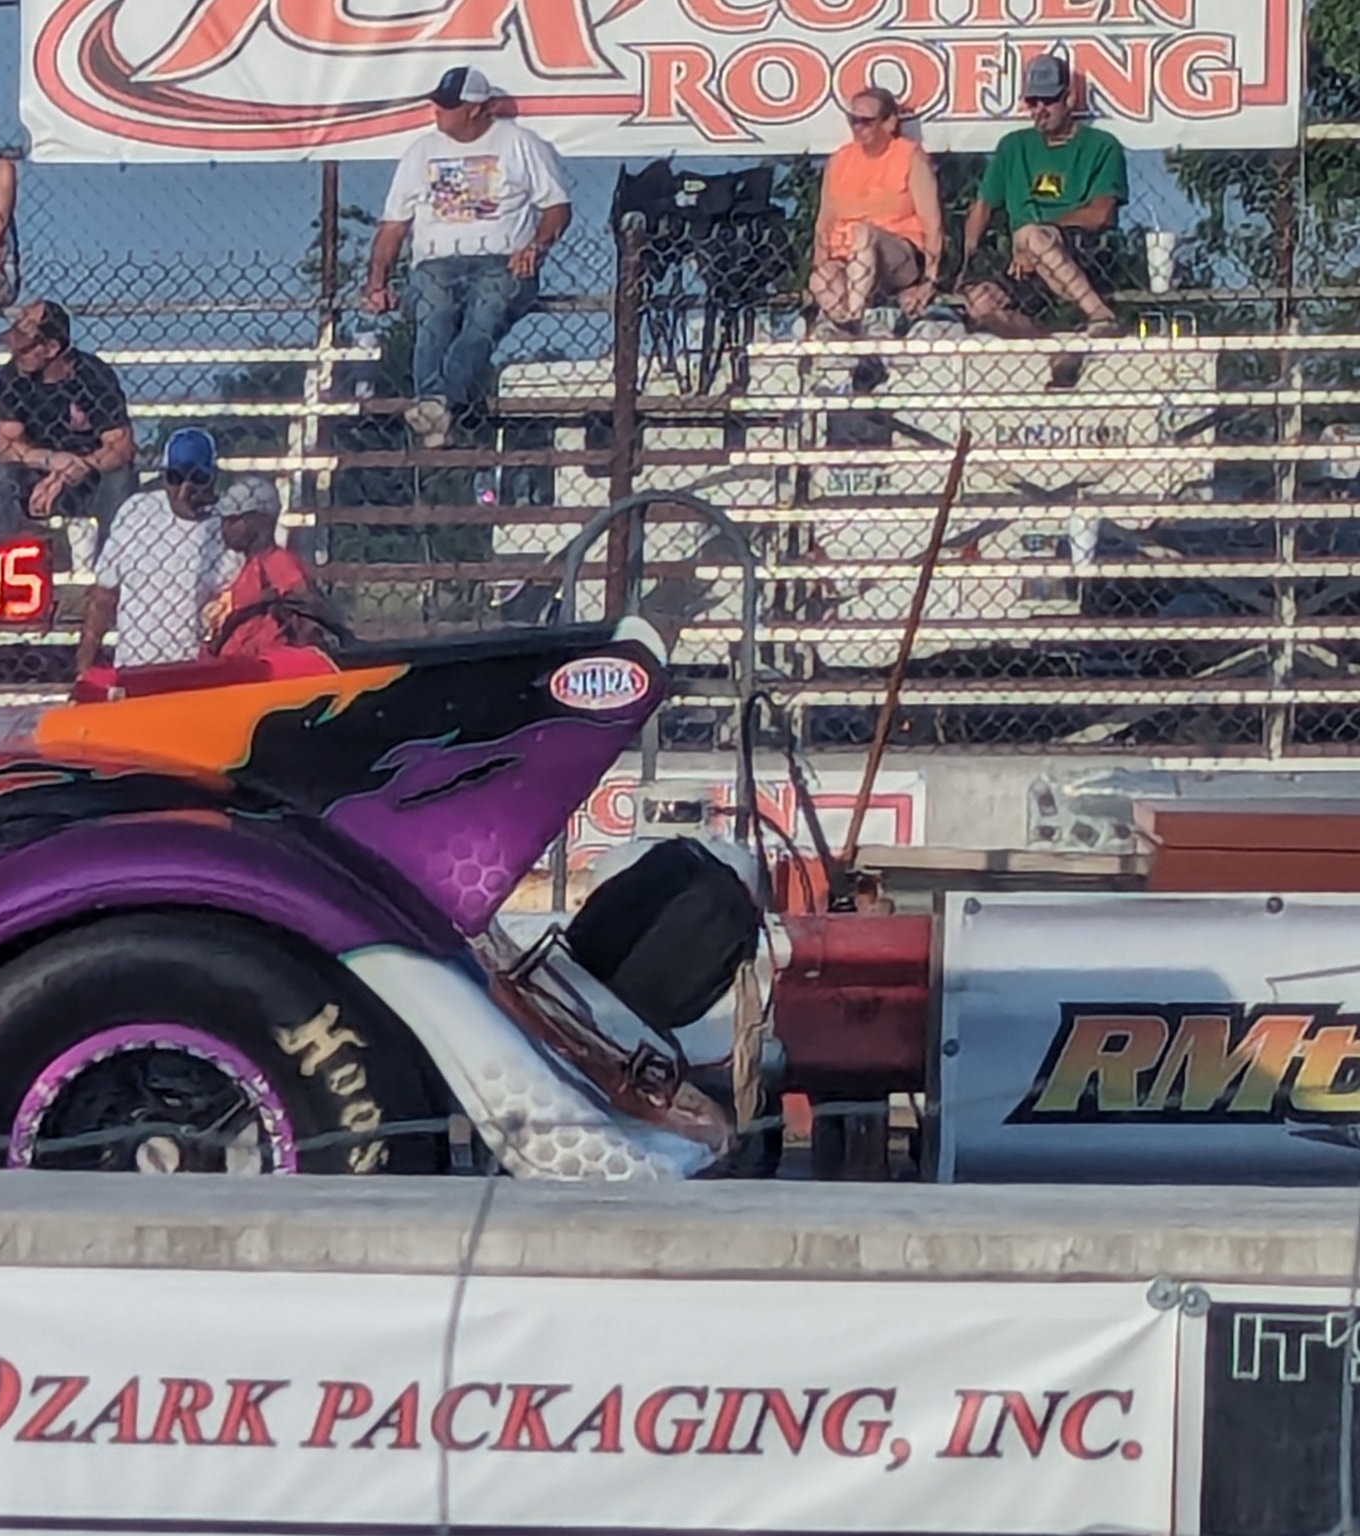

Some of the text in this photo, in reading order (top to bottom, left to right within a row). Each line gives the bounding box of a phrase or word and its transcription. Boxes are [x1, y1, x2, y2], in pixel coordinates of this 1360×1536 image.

[566, 670, 634, 695] NHRA
[300, 1380, 913, 1472] PACKAGING,
[936, 1388, 1144, 1461] INC.
